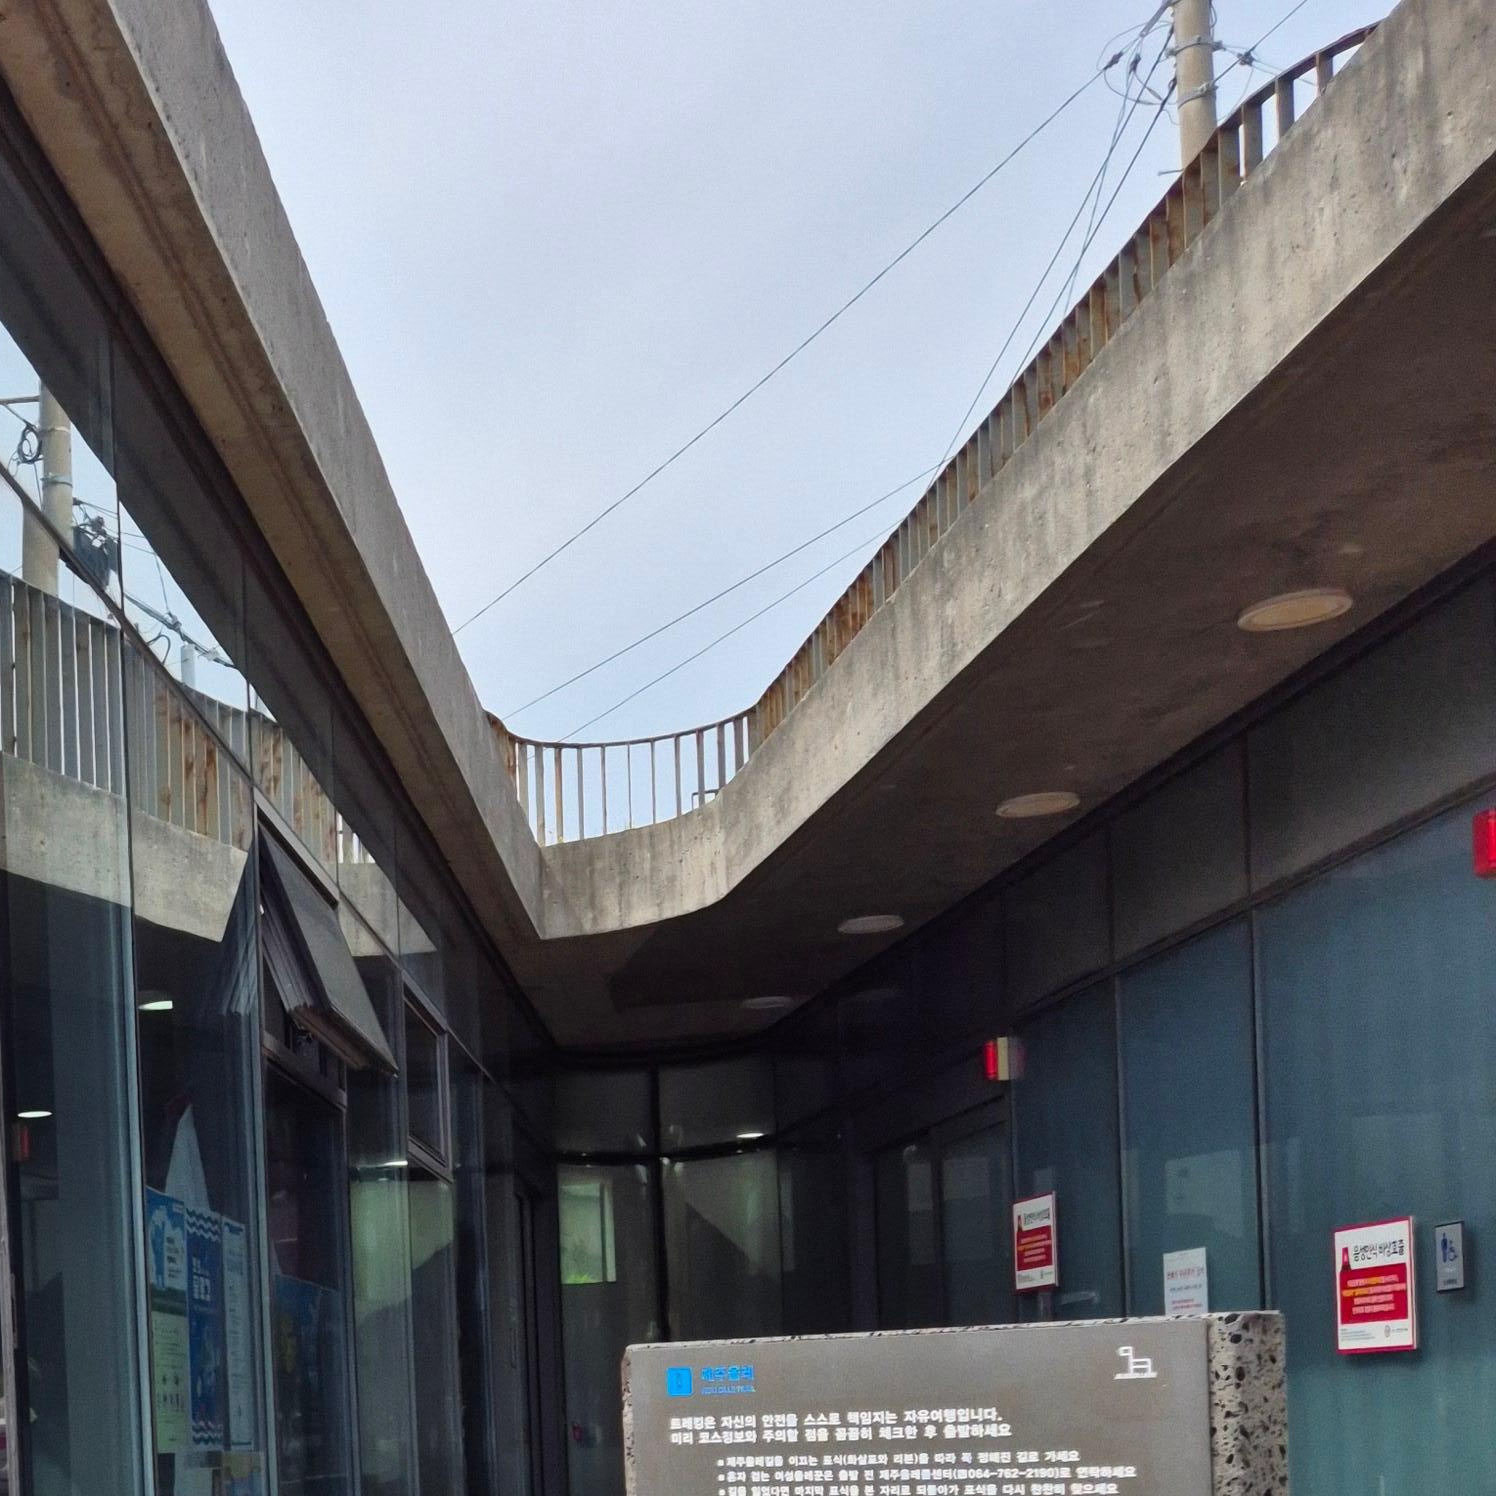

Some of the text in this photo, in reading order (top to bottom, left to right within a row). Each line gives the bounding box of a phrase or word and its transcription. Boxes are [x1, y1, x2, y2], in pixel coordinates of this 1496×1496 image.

[720, 1415, 756, 1429] 자신의
[803, 1412, 841, 1425] 스스로
[670, 1431, 693, 1445] 미리
